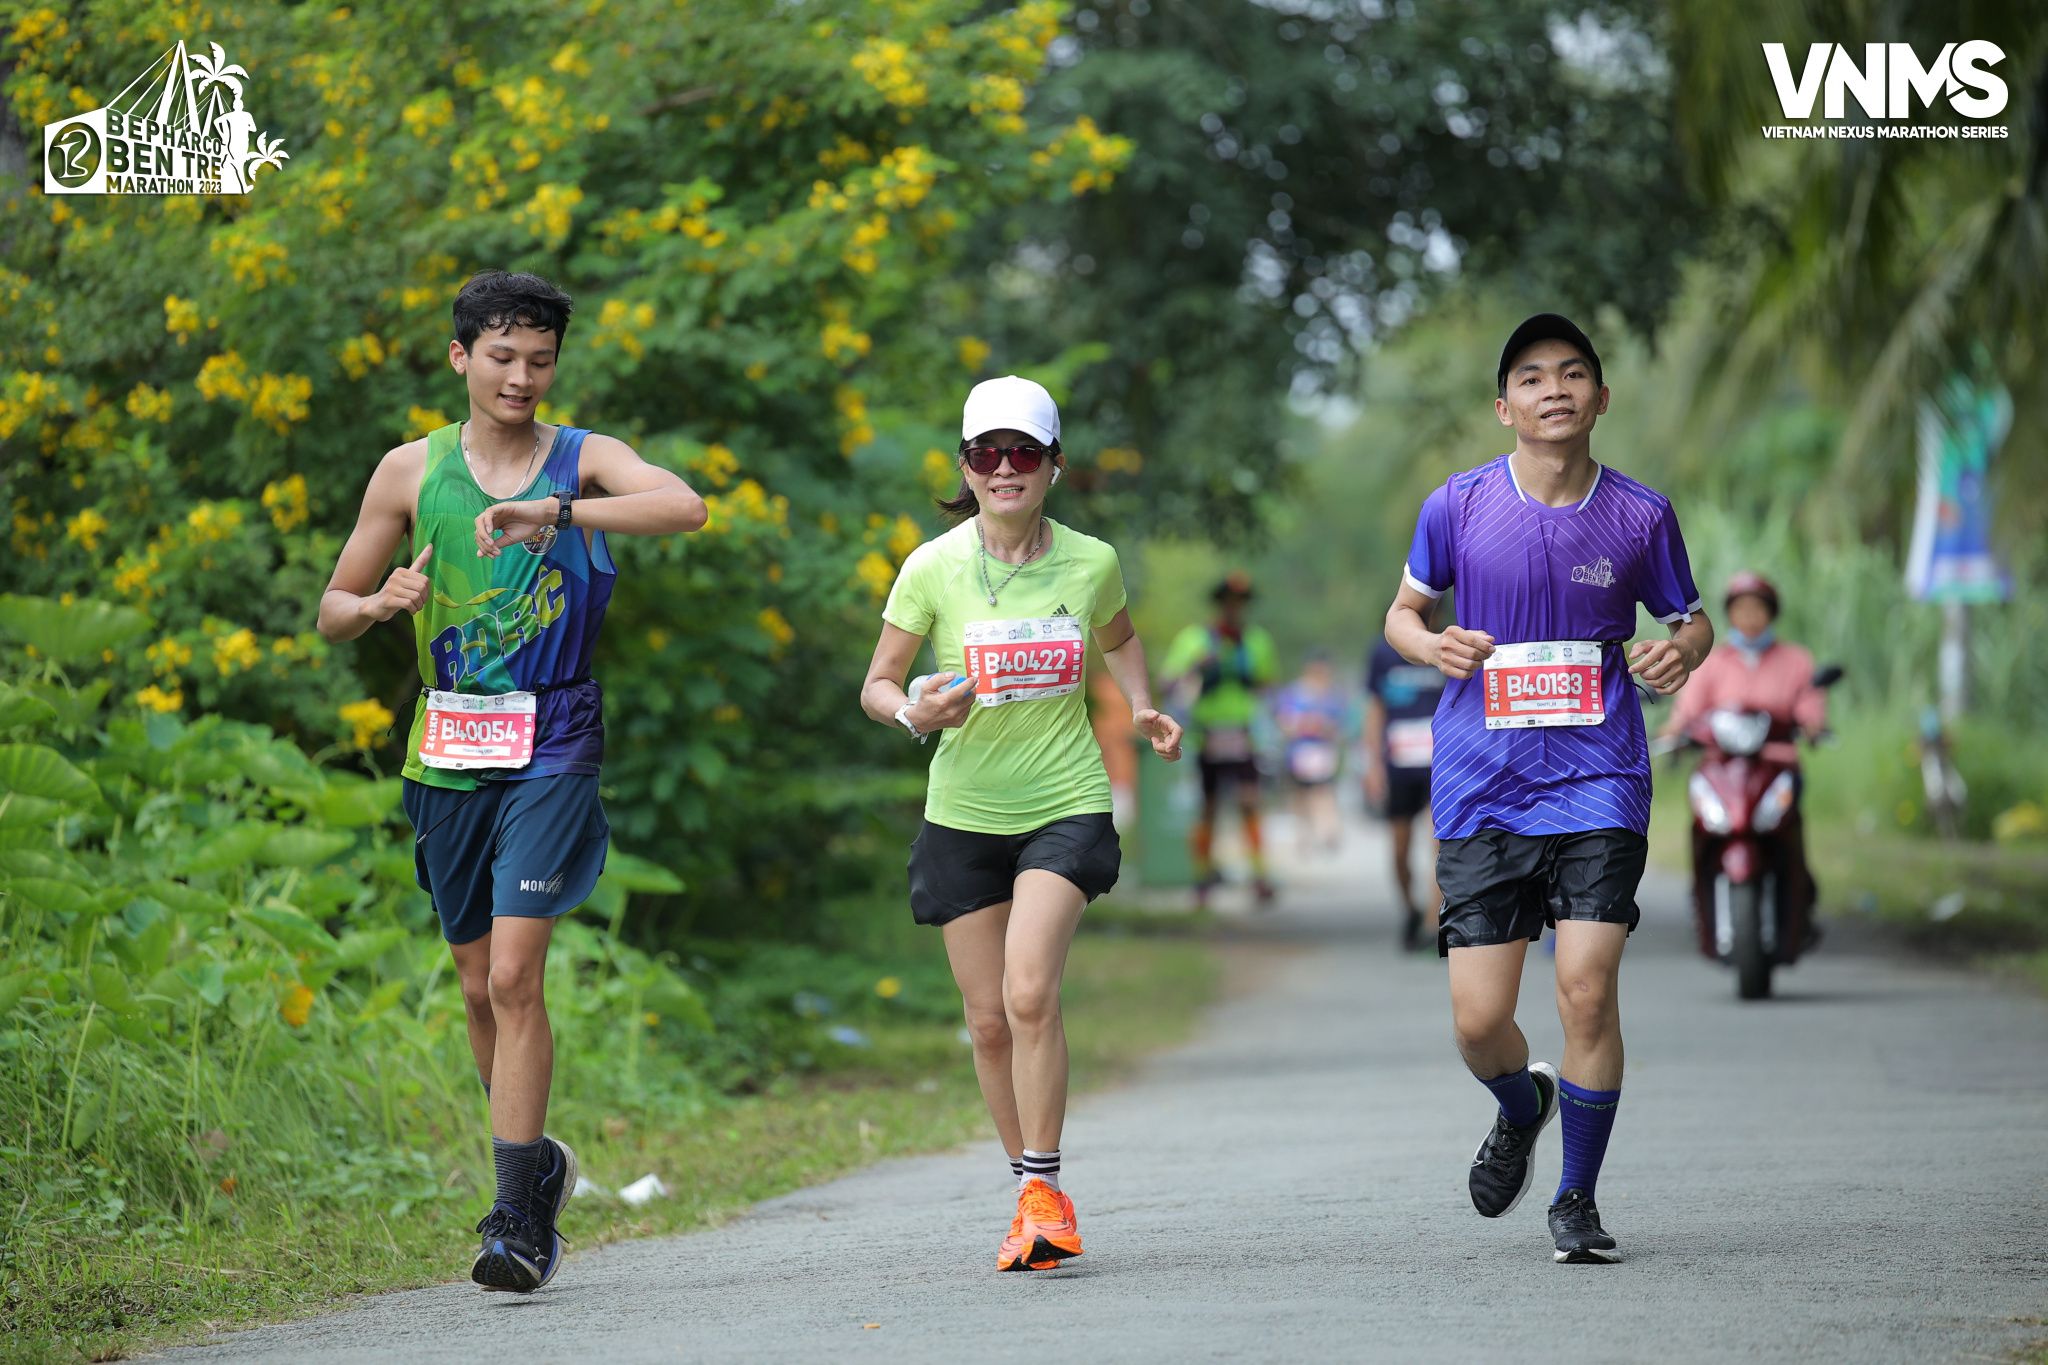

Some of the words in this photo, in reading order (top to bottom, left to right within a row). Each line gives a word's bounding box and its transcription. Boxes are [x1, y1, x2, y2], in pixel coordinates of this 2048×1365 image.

[984, 648, 1067, 675] B40422
[1488, 671, 1500, 700] 42KM
[1506, 672, 1583, 698] B40133
[427, 712, 439, 742] 42KM
[441, 718, 519, 742] B40054
